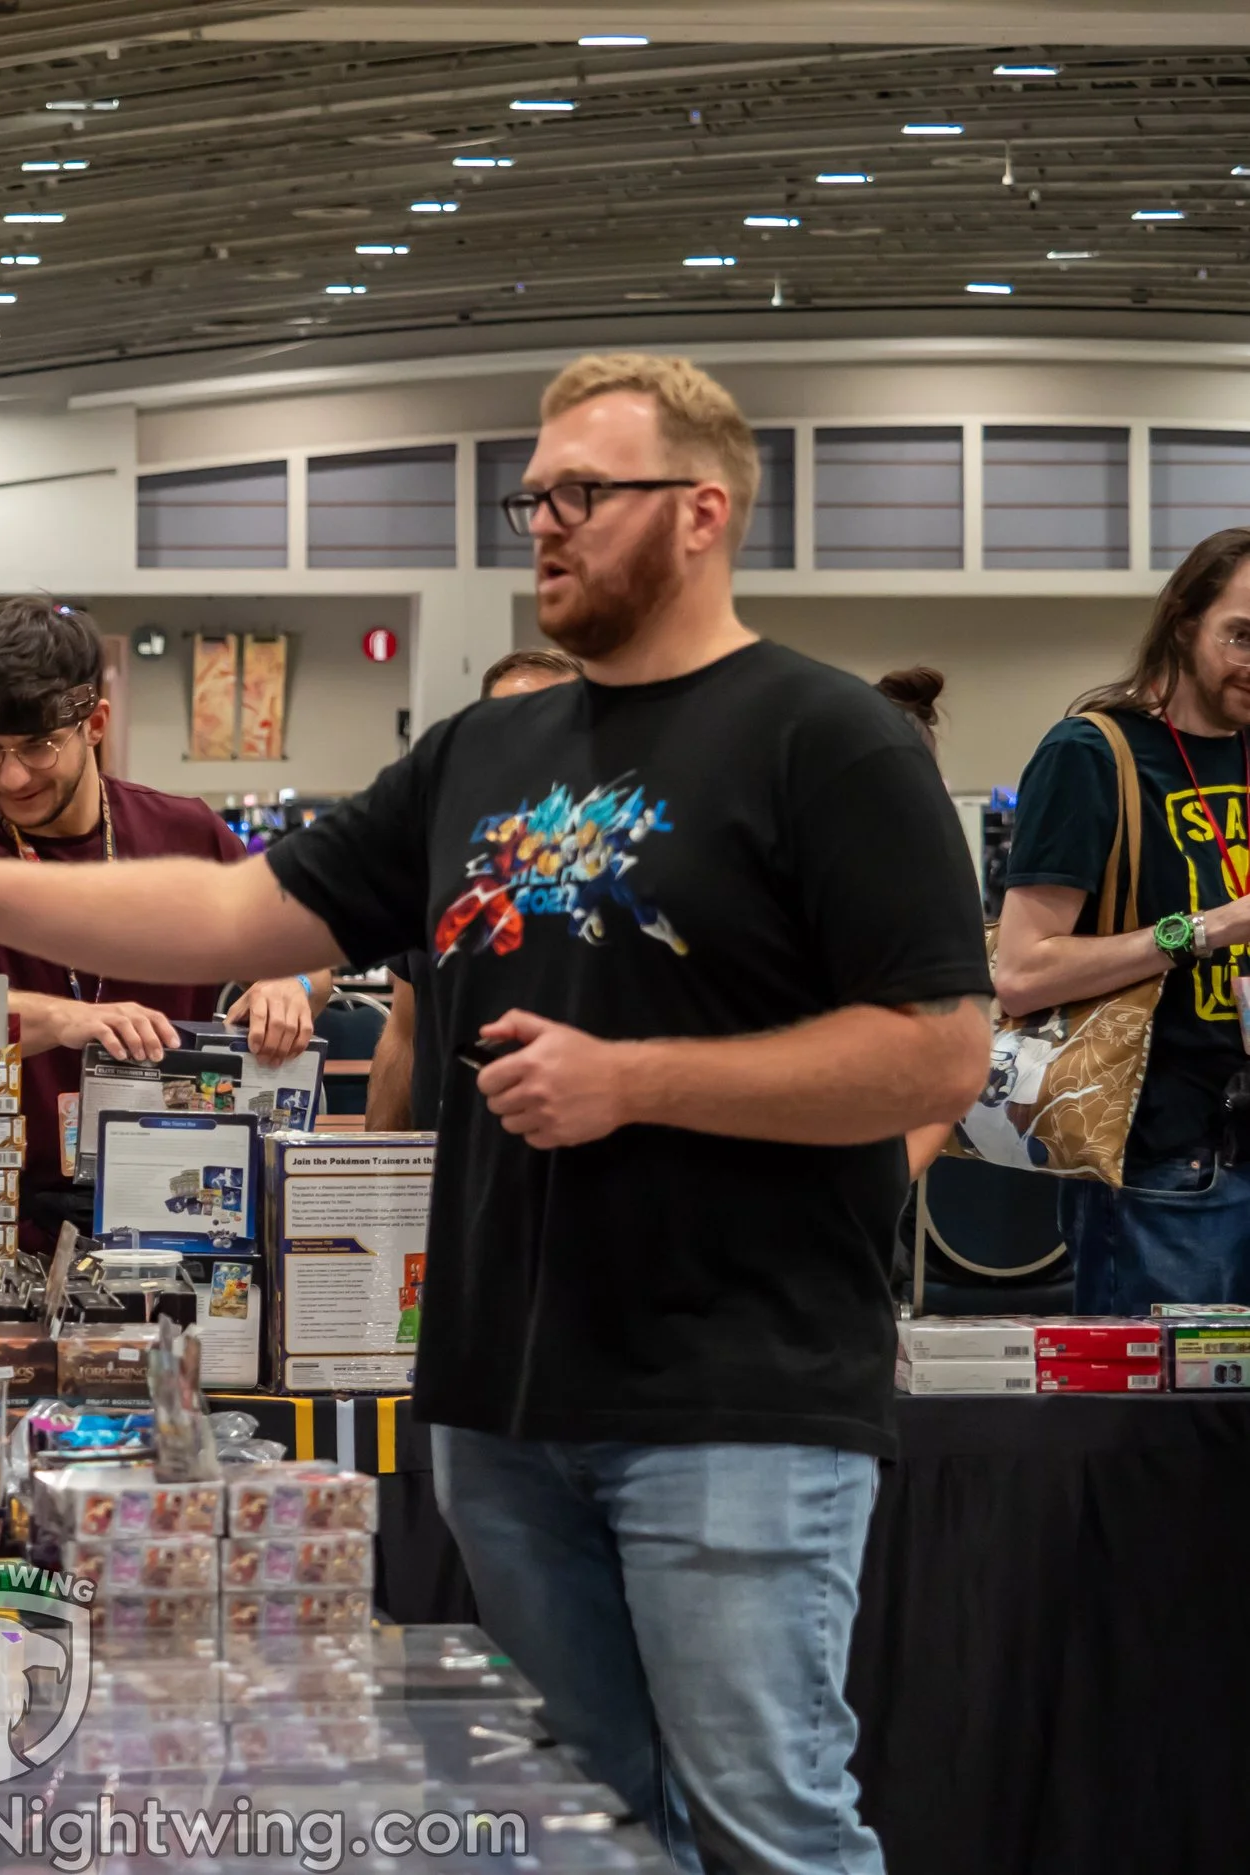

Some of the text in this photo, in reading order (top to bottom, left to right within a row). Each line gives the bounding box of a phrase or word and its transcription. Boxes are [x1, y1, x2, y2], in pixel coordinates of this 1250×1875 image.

[292, 1158, 311, 1166] Join
[313, 1157, 328, 1165] the
[330, 1156, 370, 1165] Pokémon
[372, 1157, 410, 1165] Trainers
